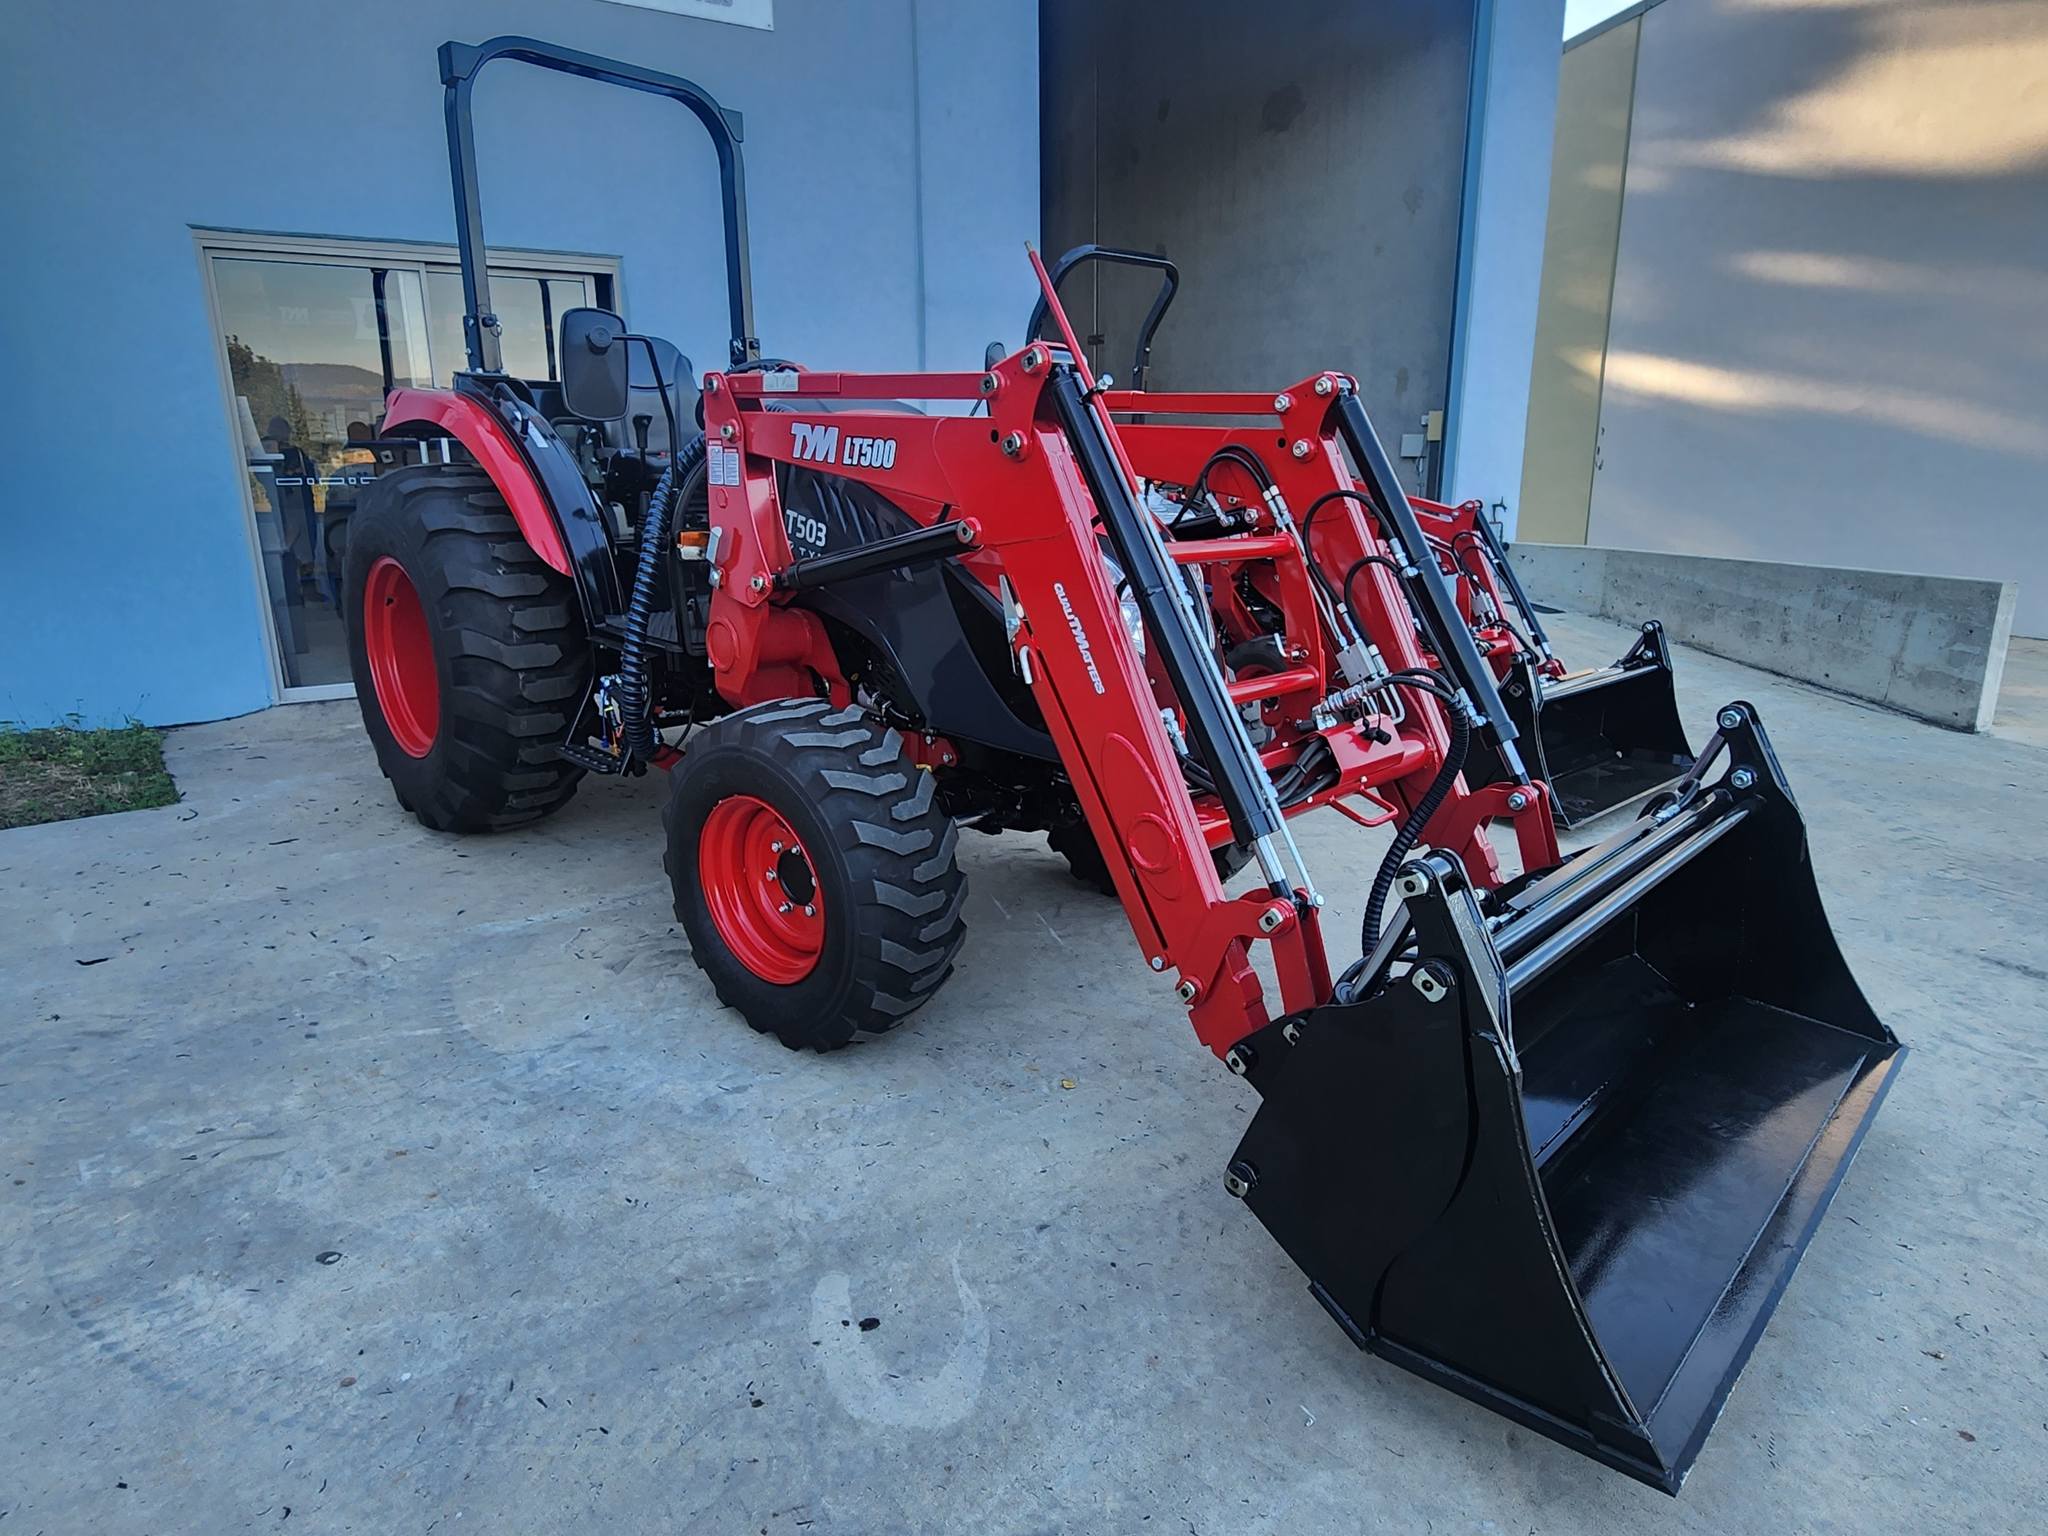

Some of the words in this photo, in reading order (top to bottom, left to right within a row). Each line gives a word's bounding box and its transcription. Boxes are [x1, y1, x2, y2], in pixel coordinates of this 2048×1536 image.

[790, 422, 839, 464] TYM
[842, 436, 897, 468] LT500
[785, 509, 827, 547] T503
